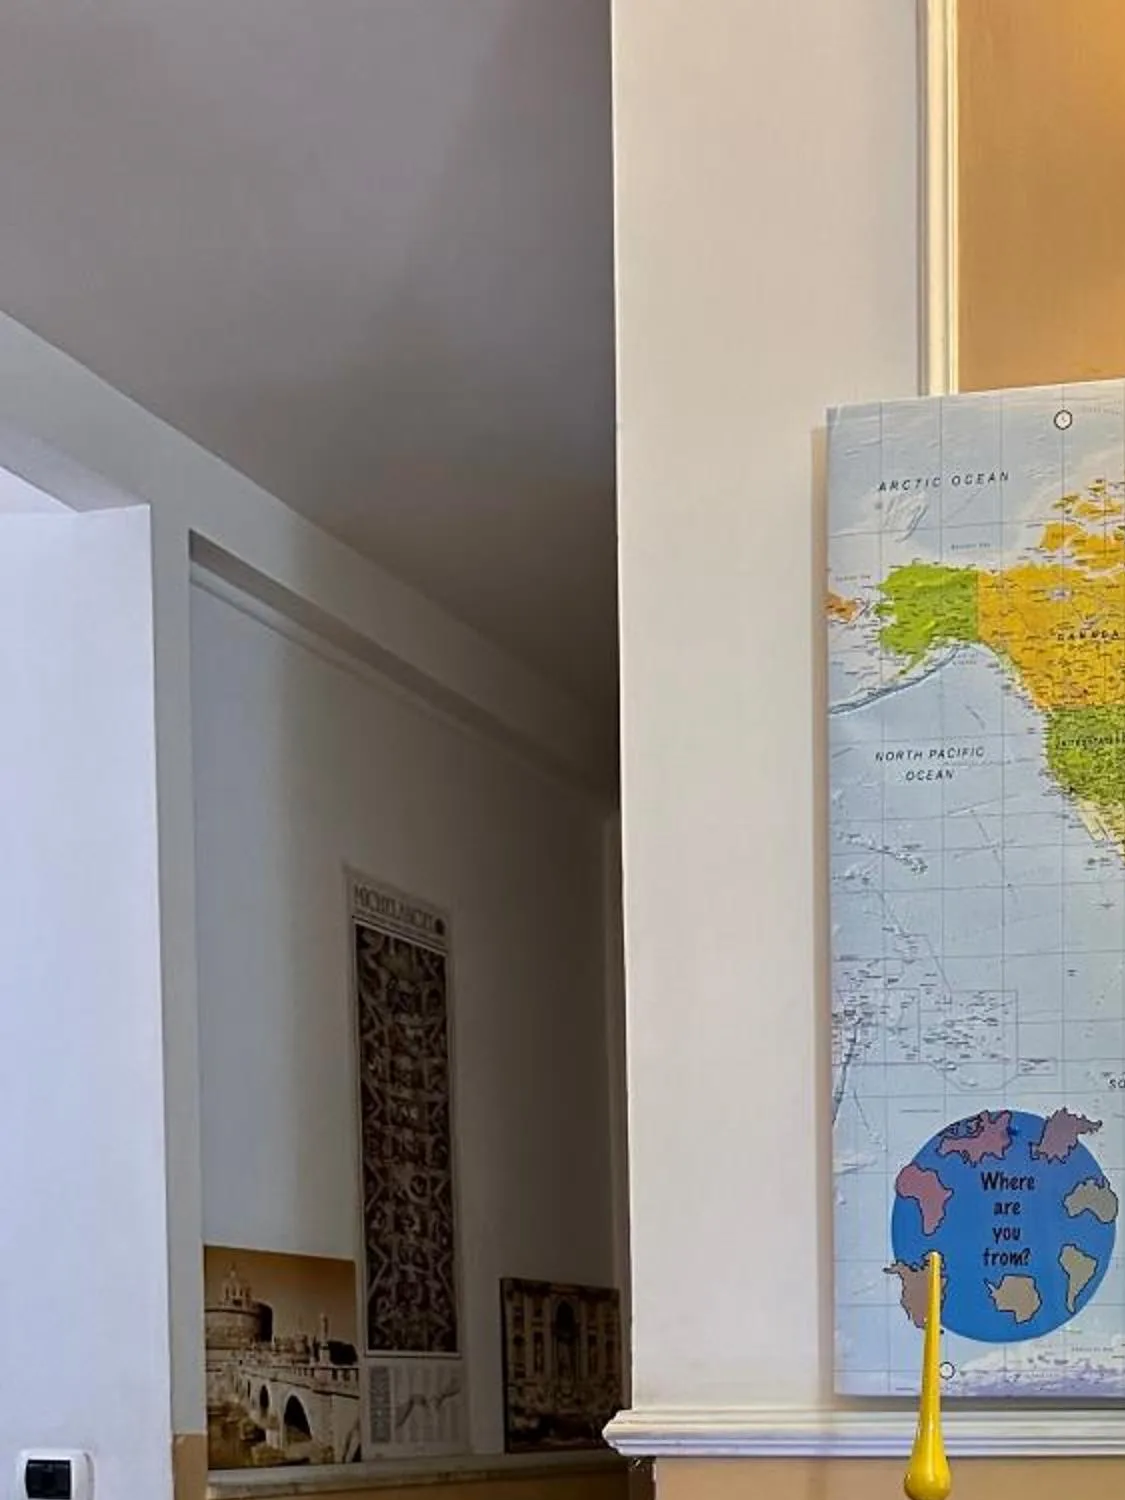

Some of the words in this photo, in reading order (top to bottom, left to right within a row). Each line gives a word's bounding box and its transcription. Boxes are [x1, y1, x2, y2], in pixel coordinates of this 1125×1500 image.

[879, 475, 941, 491] ARCTIC
[952, 471, 1009, 487] OCEAN
[875, 749, 923, 762] NORTH
[928, 746, 985, 759] PACIFIC
[905, 768, 954, 781] OCEAN
[980, 1170, 1036, 1191] Where
[994, 1201, 1021, 1215] are
[992, 1226, 1021, 1244] you
[982, 1247, 1031, 1266] from?
